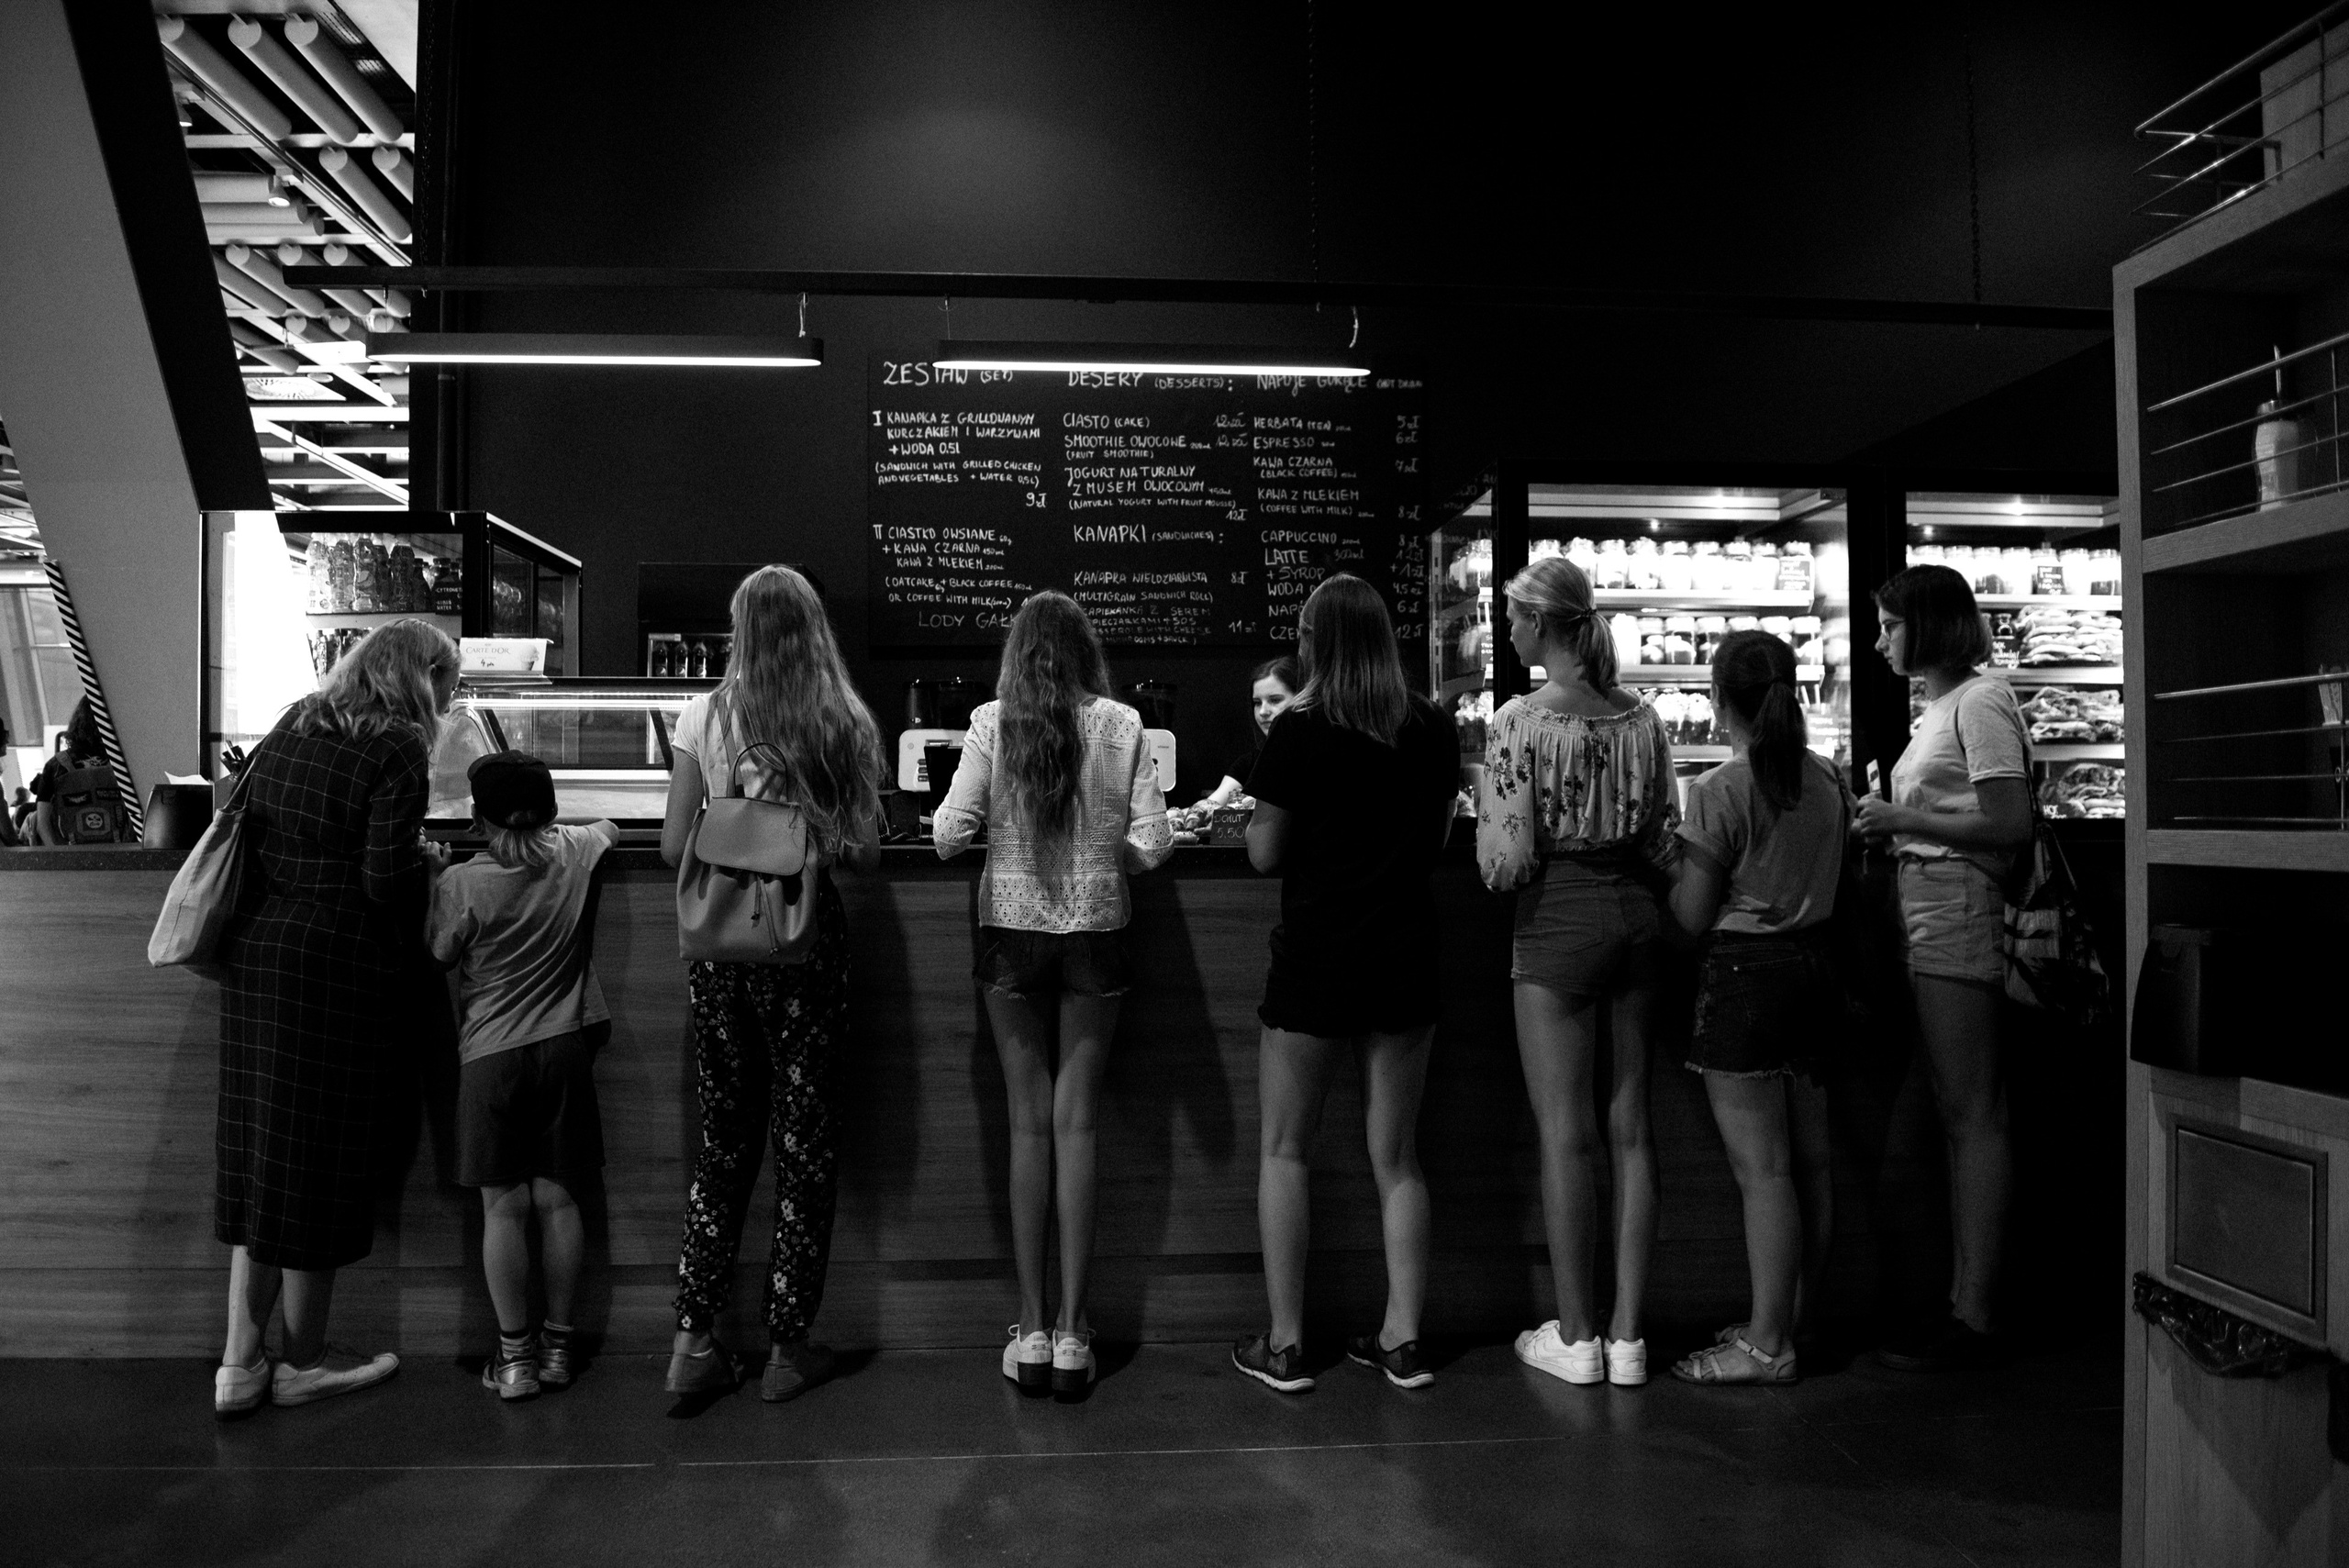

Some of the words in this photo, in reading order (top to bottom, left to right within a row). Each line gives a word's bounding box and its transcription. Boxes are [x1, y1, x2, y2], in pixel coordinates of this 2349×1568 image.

[1068, 373, 1143, 388] DESERY
[886, 412, 937, 424] KANAPKA
[941, 413, 951, 424] Z
[957, 413, 1035, 426] GRILLOWANYM
[1063, 413, 1109, 429] CIASTO
[1114, 417, 1150, 428] (CAKE)
[1253, 417, 1303, 429] HERBATA
[886, 427, 958, 439] KURCZAKIEM
[976, 427, 1041, 439] WARZYWAMI
[1063, 434, 1126, 449] SMOOTHIE
[1130, 435, 1186, 448] OWOCOWE
[1253, 436, 1315, 450] ESPRESSO
[901, 443, 934, 455] WODA
[1066, 450, 1094, 461] (FRUIT
[1104, 450, 1154, 459] SMOOTHIE)
[875, 462, 928, 473] (SANDWICH
[932, 462, 955, 470] WITH
[963, 460, 1001, 469] GRILLED
[1004, 461, 1041, 472] CHICKEN
[1252, 456, 1283, 468] KAWA
[1288, 457, 1333, 467] CZARNA
[980, 473, 1012, 481] WATER
[1064, 467, 1115, 487] JOGURT
[1119, 465, 1196, 478] NATURALNY
[1260, 469, 1296, 478] (BLACK
[1299, 468, 1338, 478] COFFEE)
[1073, 484, 1082, 496] Z
[1086, 480, 1136, 495] MUSEM
[1143, 480, 1205, 492] OWOCOWYM
[1257, 487, 1287, 500] KAWA
[1291, 490, 1298, 500] Z
[1303, 489, 1359, 501] MLEKIEM
[1068, 499, 1113, 510] (NATURAL
[1205, 499, 1236, 509] MOUSSE)
[1260, 505, 1297, 514] (COFFEE
[1300, 506, 1322, 514] WITH
[1327, 506, 1353, 517] MILK)
[888, 527, 936, 539] CIASTKO
[942, 528, 996, 541] OWSIANE
[1074, 524, 1146, 543] KANAPKI
[1261, 530, 1338, 543] CAPPUCCINO
[894, 543, 927, 554] KAWA
[935, 542, 980, 553] CZARNA
[1265, 548, 1309, 565] LATTE
[896, 557, 921, 568] KAWA
[927, 557, 932, 567] Z
[938, 556, 983, 571] MLEKIEM
[1074, 571, 1127, 586] KANAPKA
[1279, 566, 1326, 581] SYROP
[885, 576, 935, 587] (OATCAKE
[949, 578, 975, 587] BLACK
[979, 580, 1012, 588] COFFEE
[1267, 583, 1303, 596] WODA
[888, 594, 901, 602] OR
[907, 593, 941, 602] COFFEE
[946, 595, 968, 605] WITH
[1073, 592, 1136, 602] (MULTIGRAIN
[1141, 592, 1186, 600] SANDWICH
[1190, 592, 1213, 604] ROLL)
[1170, 606, 1210, 617] SEREM
[918, 611, 964, 628] LODY
[1092, 617, 1161, 627] PIECZARKAMI
[1173, 617, 1197, 626] SOS
